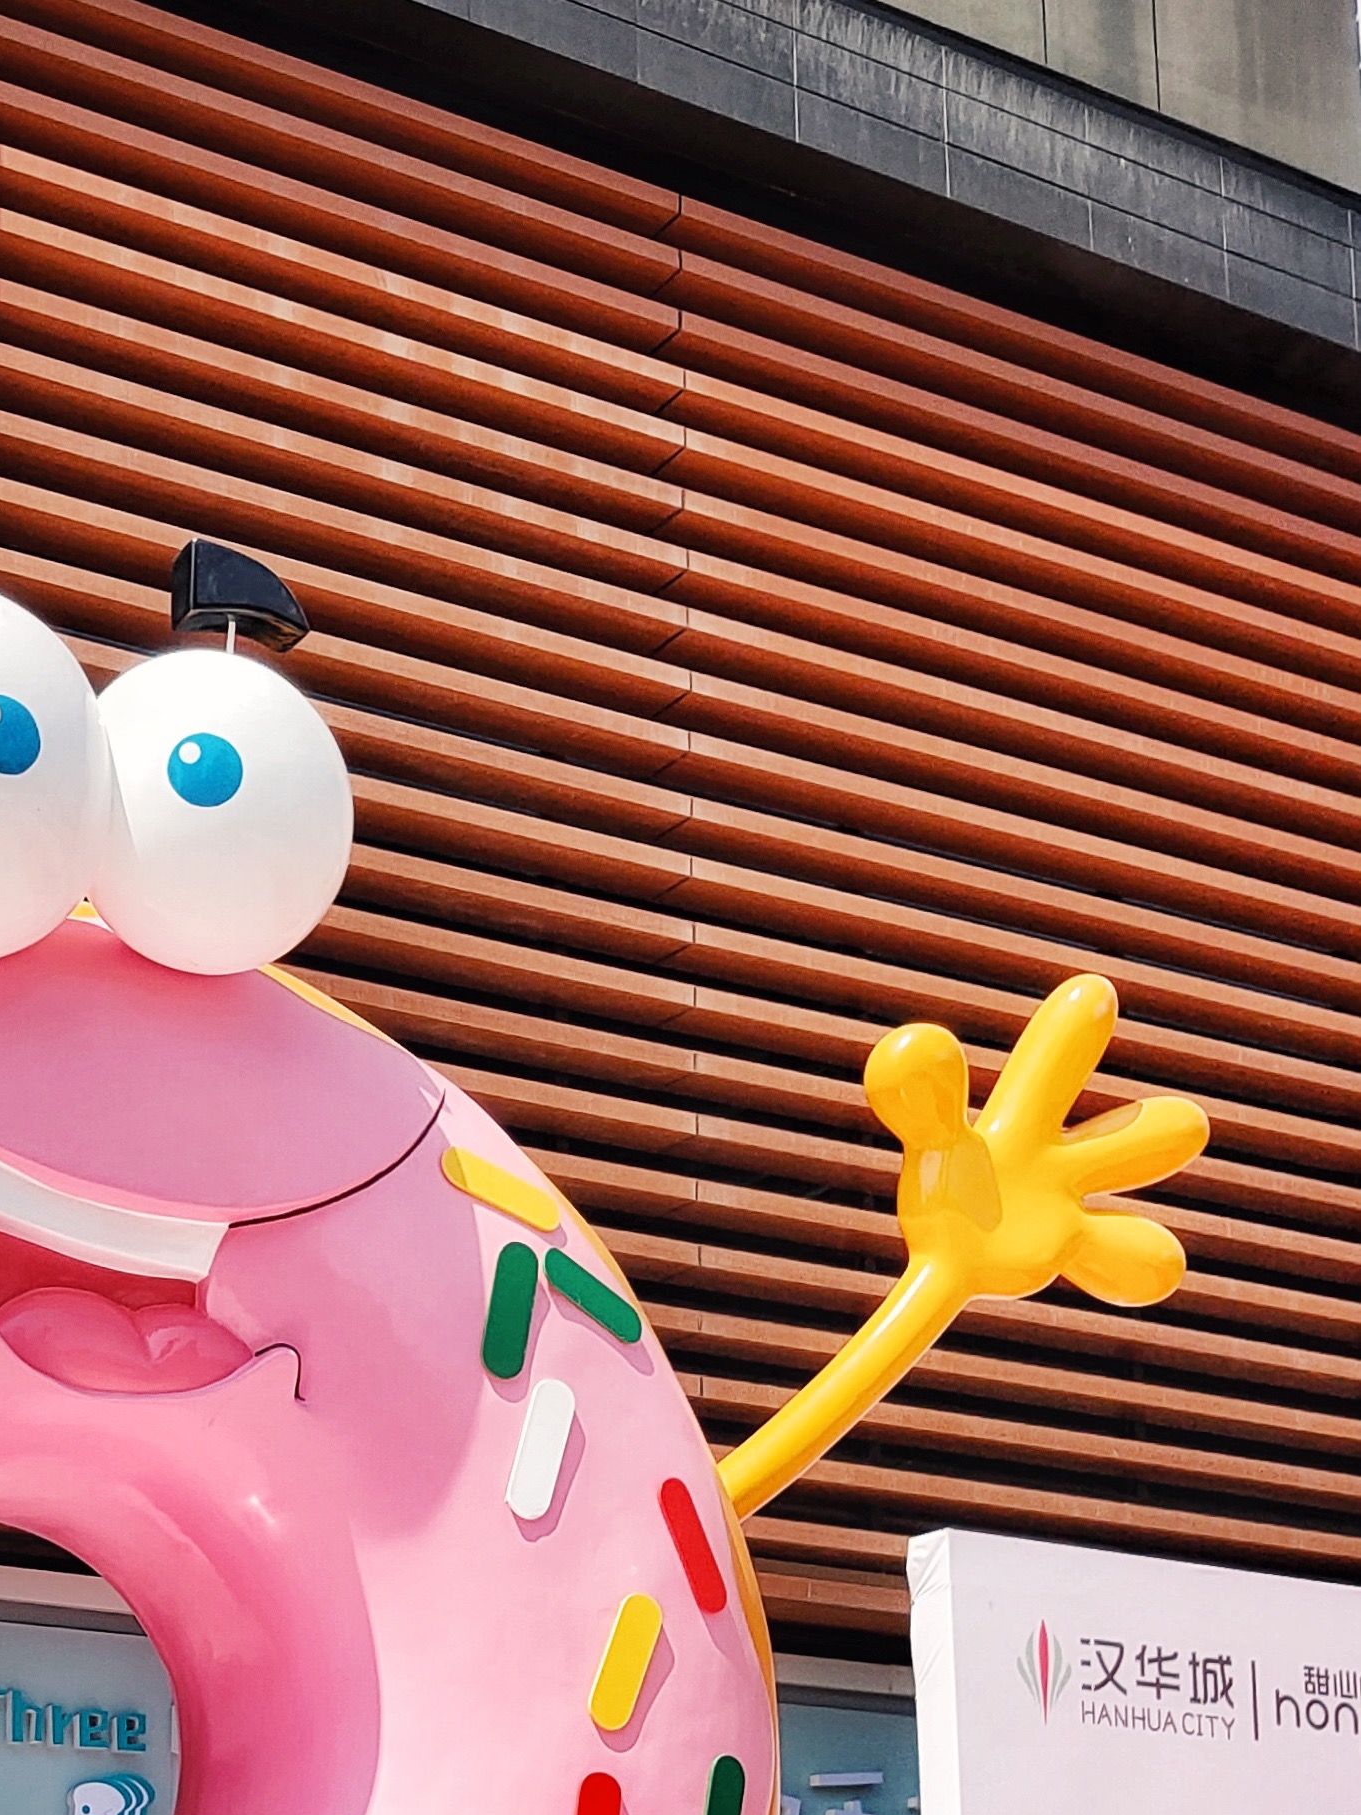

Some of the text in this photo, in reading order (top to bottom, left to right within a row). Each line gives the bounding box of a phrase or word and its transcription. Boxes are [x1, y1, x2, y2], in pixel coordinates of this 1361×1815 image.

[1080, 1637, 1235, 1709] 汉华城
[1081, 1700, 1236, 1741] HANHUA CITY
